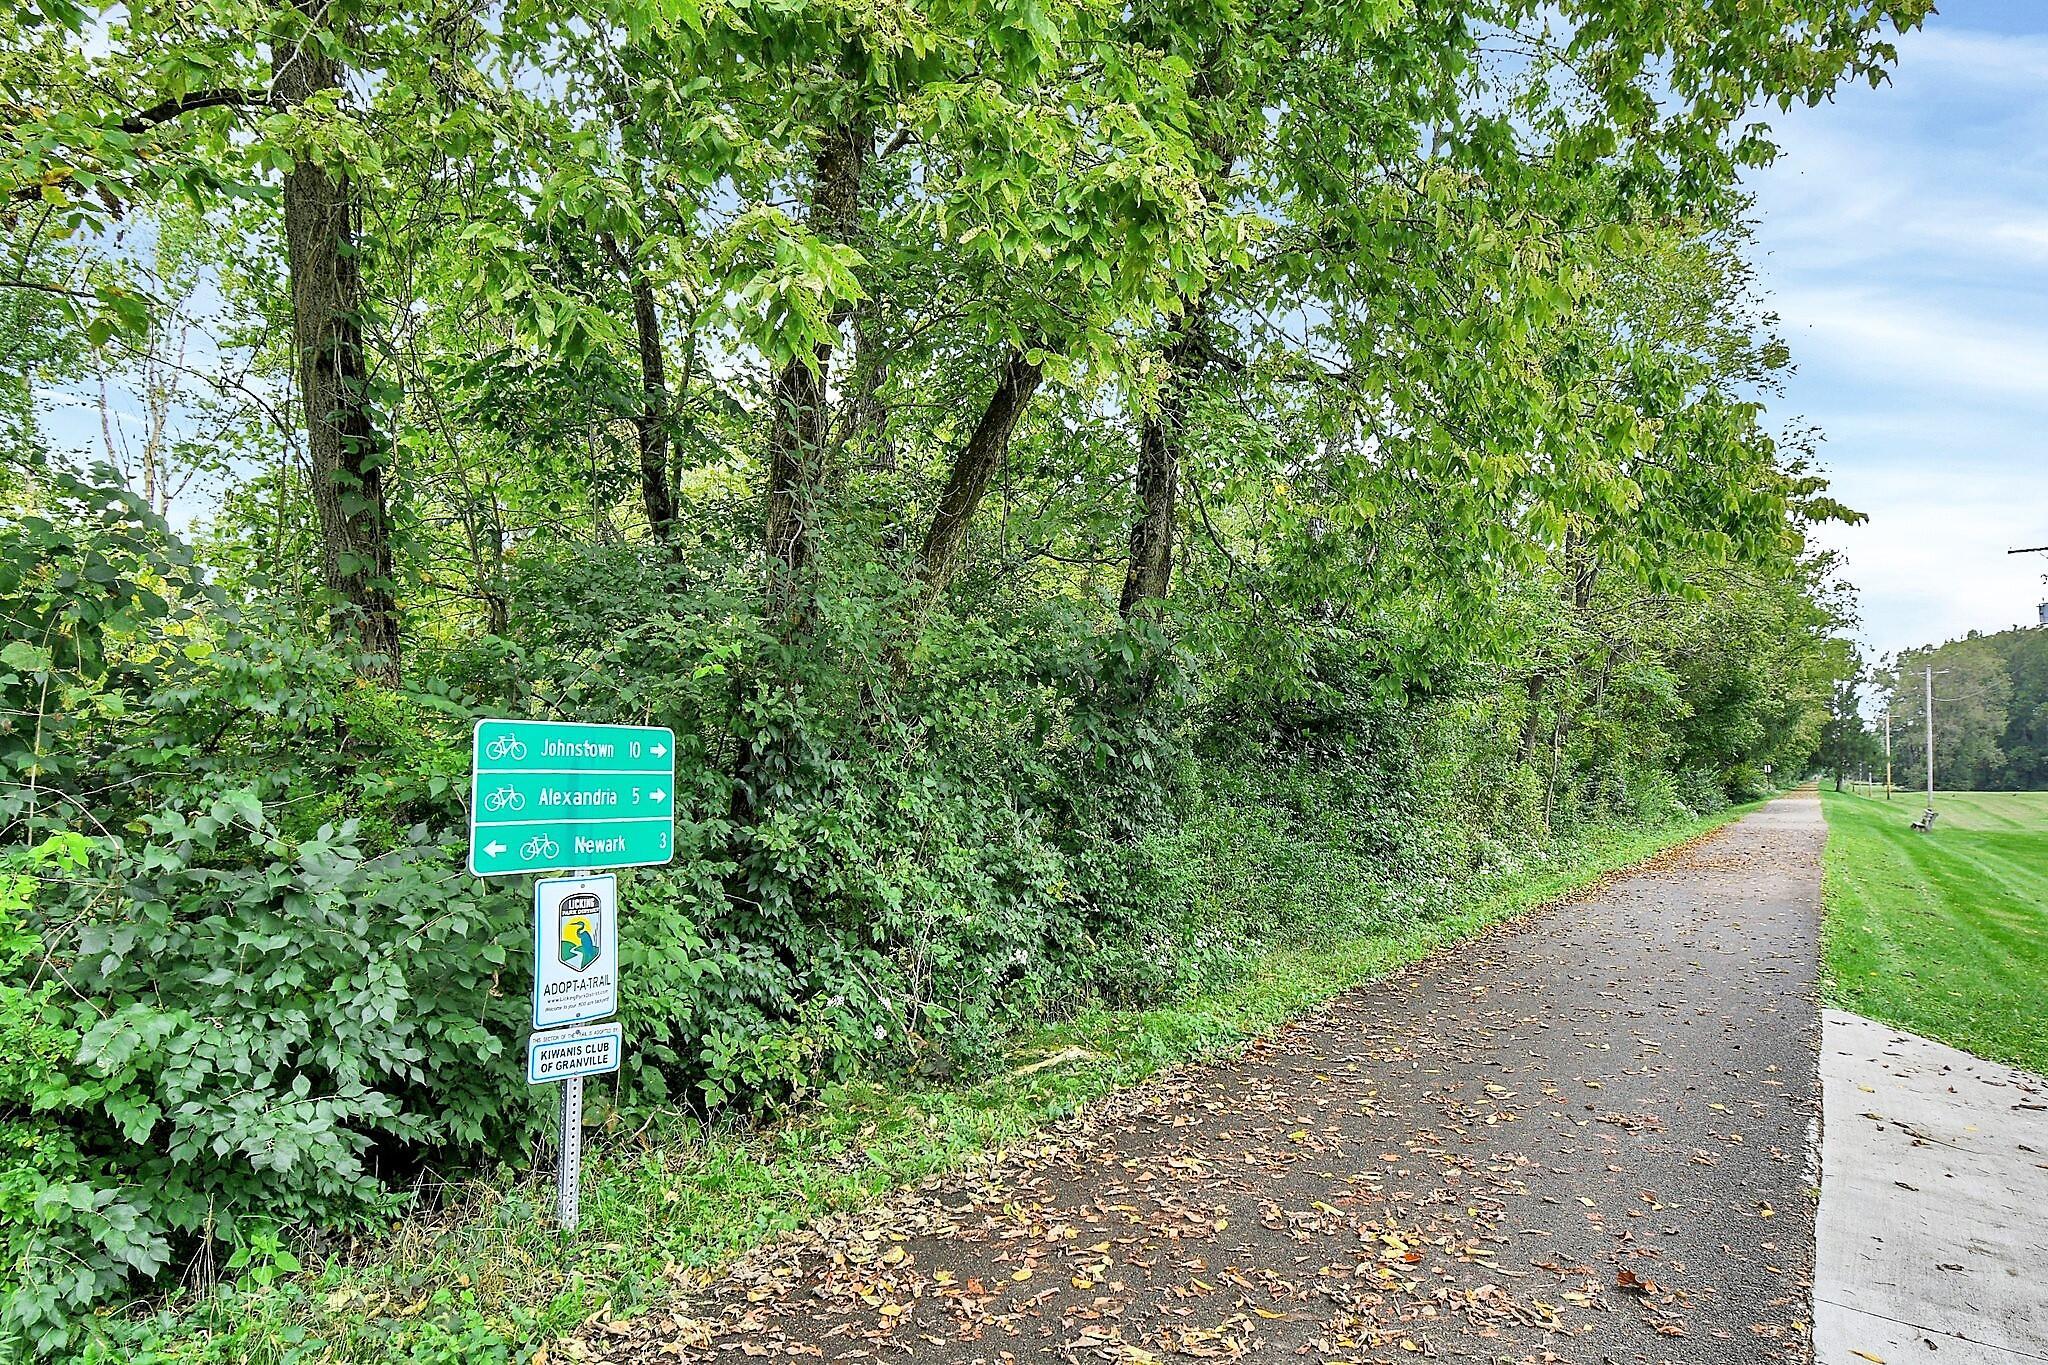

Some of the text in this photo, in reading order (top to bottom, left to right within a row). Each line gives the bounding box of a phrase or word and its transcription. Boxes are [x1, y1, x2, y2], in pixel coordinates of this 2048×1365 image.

[541, 739, 641, 759] Johnstown 10
[538, 788, 640, 806] Alexandria 5
[574, 832, 667, 854] Newark 3
[568, 898, 595, 909] LICKING
[543, 974, 611, 996] ADOPT-A-TRAIL
[540, 1042, 609, 1061] KIWANIS CLUB
[541, 1054, 609, 1073] OF GRANVILLE
